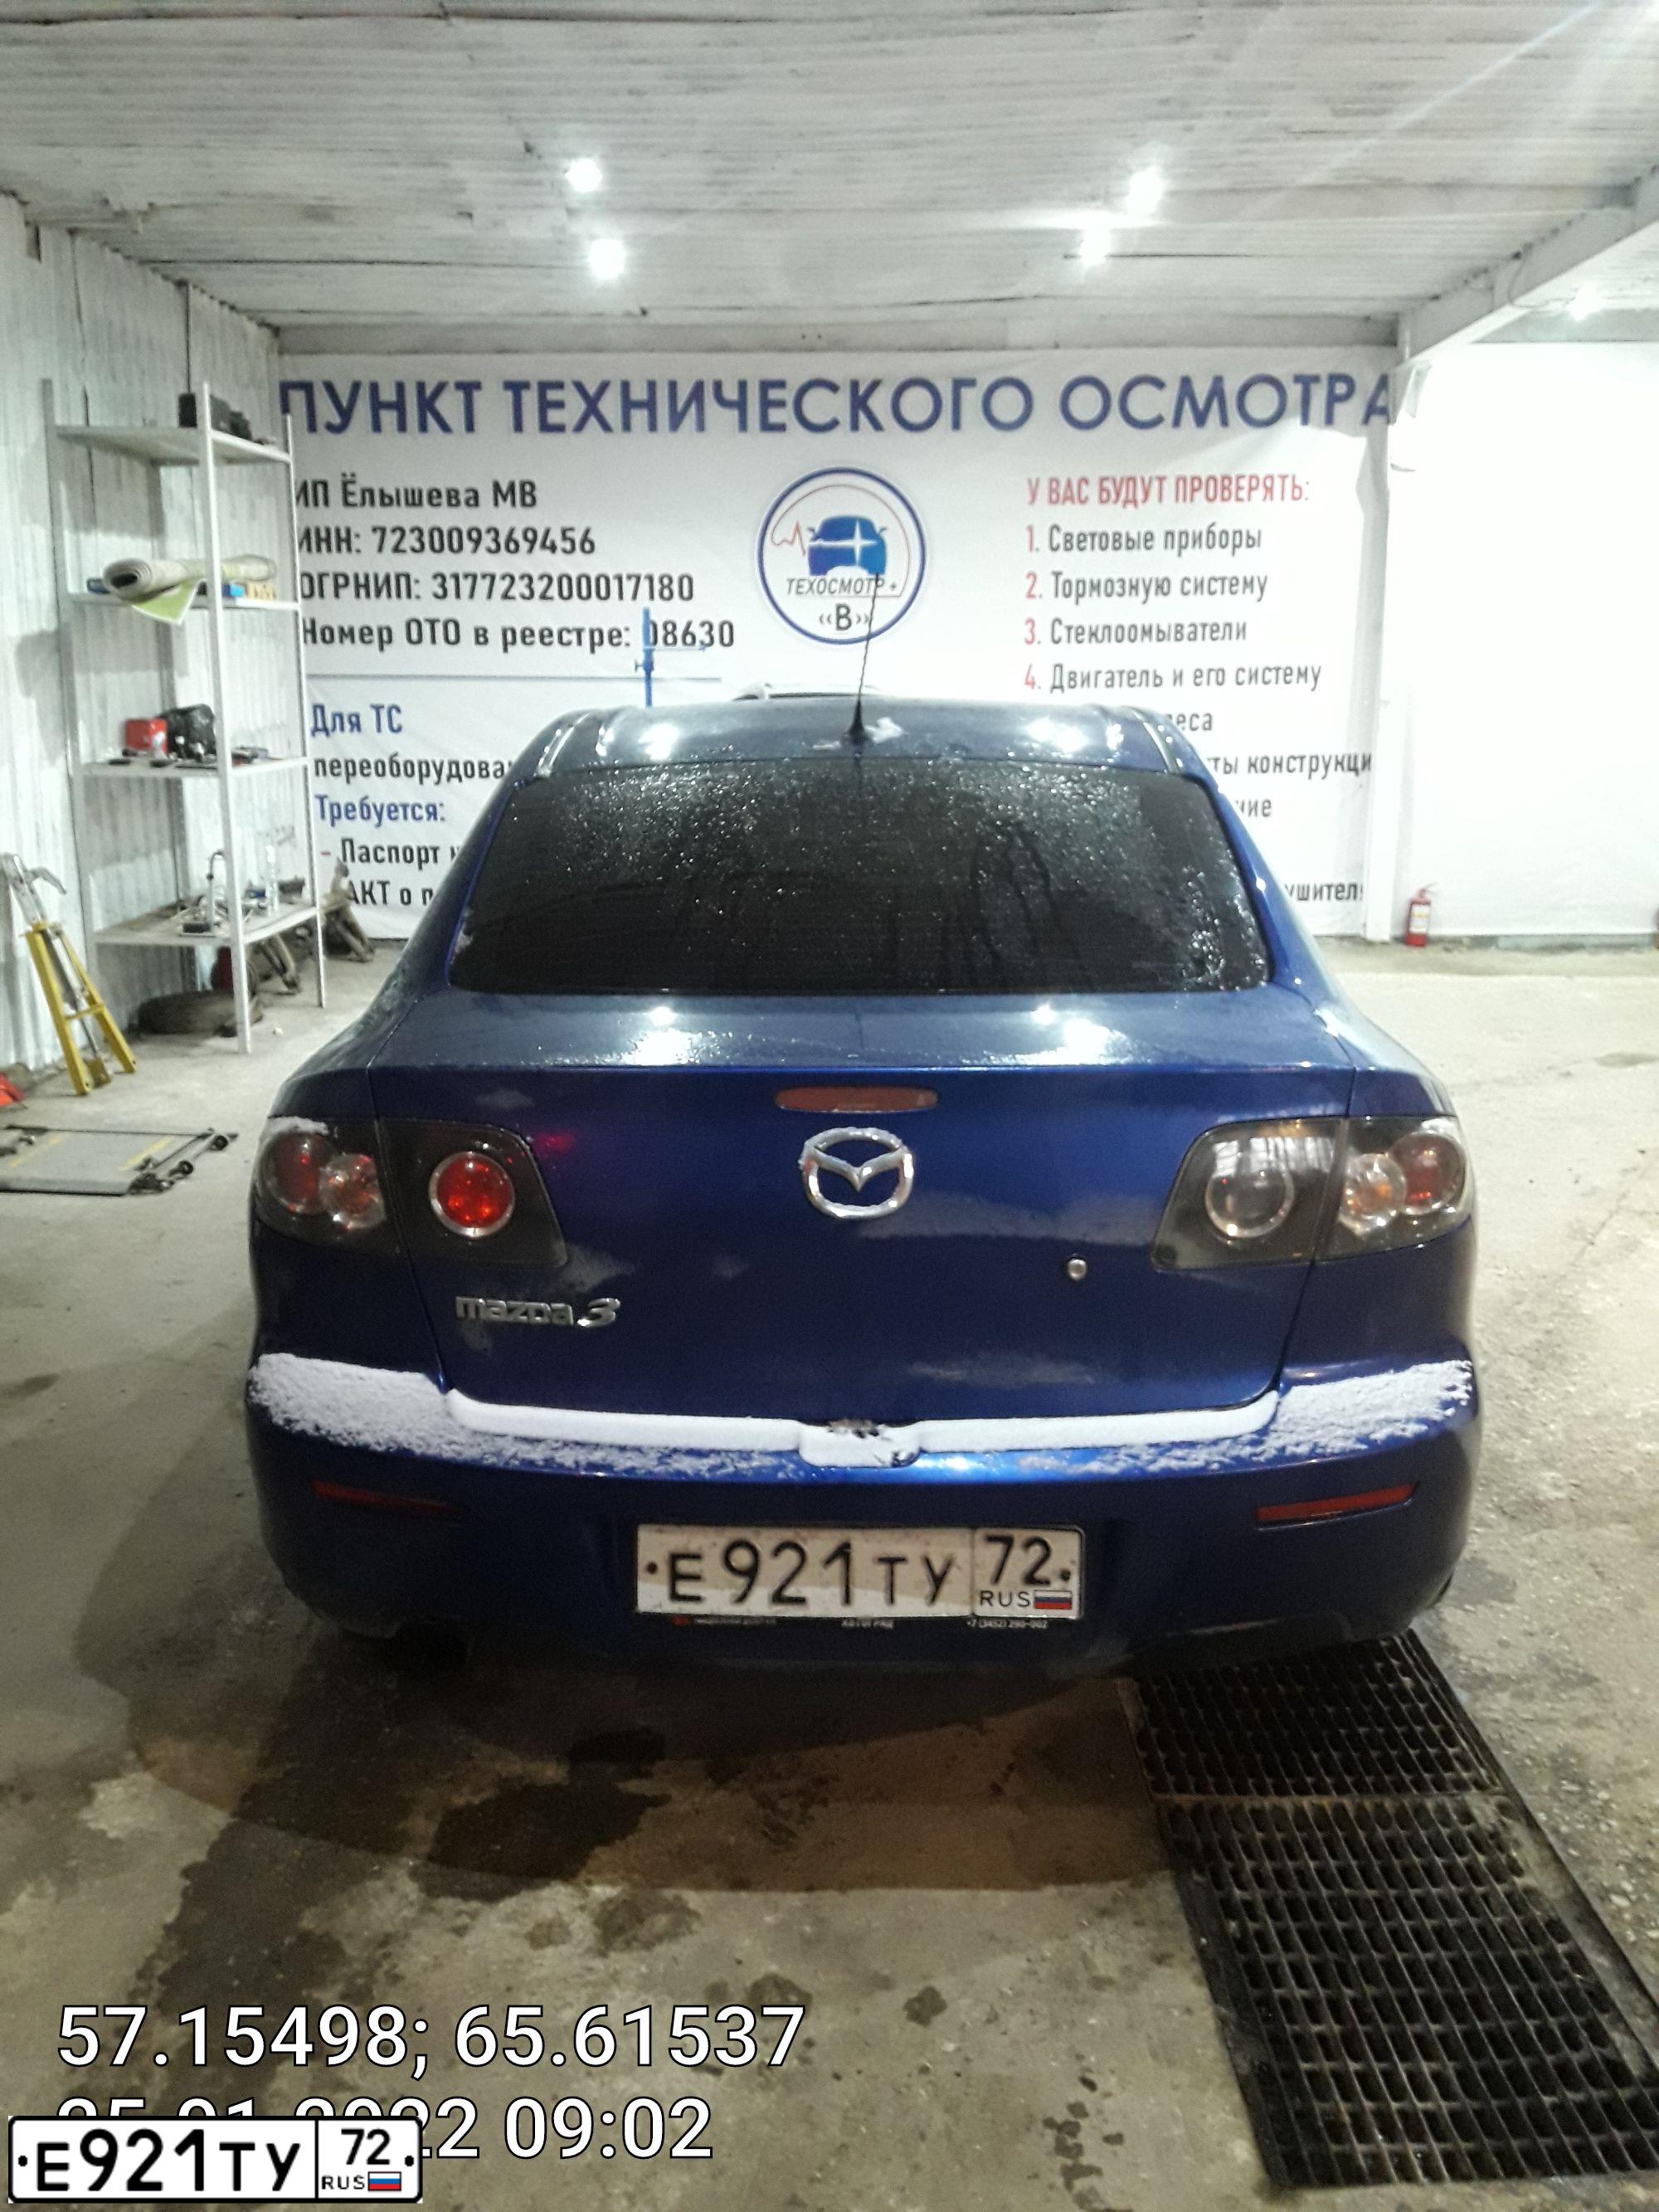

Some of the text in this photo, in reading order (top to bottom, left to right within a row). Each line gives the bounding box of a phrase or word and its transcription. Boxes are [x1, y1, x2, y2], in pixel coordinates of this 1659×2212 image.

[279, 373, 1390, 434] ПУНКТ ТЕХНИЧЕСКОГО ОСМОТРА
[296, 472, 538, 508] ИП Ёлышева МВ
[1027, 474, 1311, 509] У ВАС БУДУТ ПРОВЕРЯТЬ:
[299, 525, 596, 554] ИНН: 723009369456
[1025, 522, 1262, 557] 1. Световые приборы
[300, 571, 695, 602] ОГРНИП: 317723200017180
[786, 577, 885, 595] ТЕХОСМОТР
[1025, 570, 1268, 606] 2. Тормозную систему
[303, 617, 394, 653] Номер
[404, 617, 461, 646] ОТО
[474, 626, 489, 646] в
[501, 626, 631, 653] реестре:
[1024, 616, 1247, 645] 3. Стеклоомыватели
[1024, 663, 1322, 694] 4. Двигатель и его систему
[310, 703, 403, 738] Для ТС
[314, 753, 512, 783] переоборудова
[1248, 752, 1373, 780] конструкци
[314, 794, 445, 827] Требуется:
[341, 837, 440, 870] Паспорт
[399, 888, 412, 906] о
[577, 1298, 621, 1327] 3
[983, 1534, 1053, 1586] 72
[980, 1590, 1031, 1608] RUS
